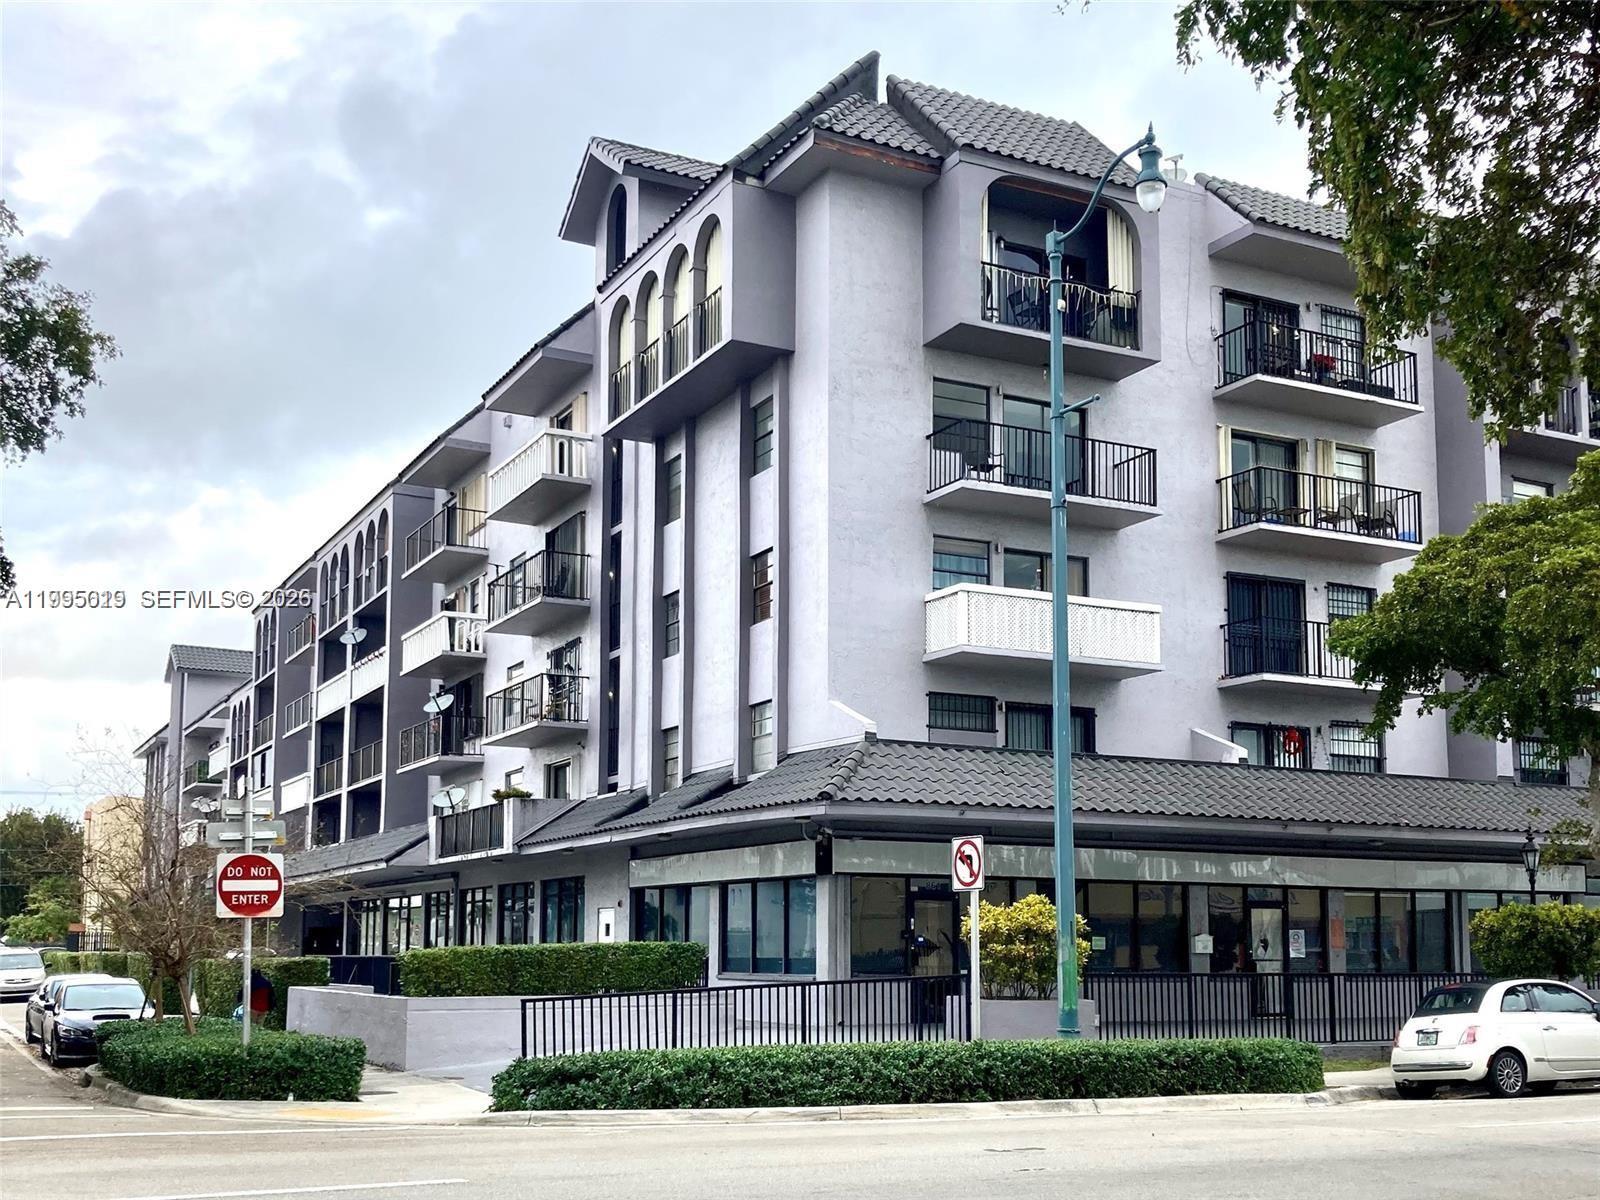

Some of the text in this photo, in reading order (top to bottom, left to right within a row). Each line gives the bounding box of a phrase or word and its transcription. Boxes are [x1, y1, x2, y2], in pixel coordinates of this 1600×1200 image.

[227, 866, 273, 877] DO NOT
[231, 894, 269, 904] ENTER
